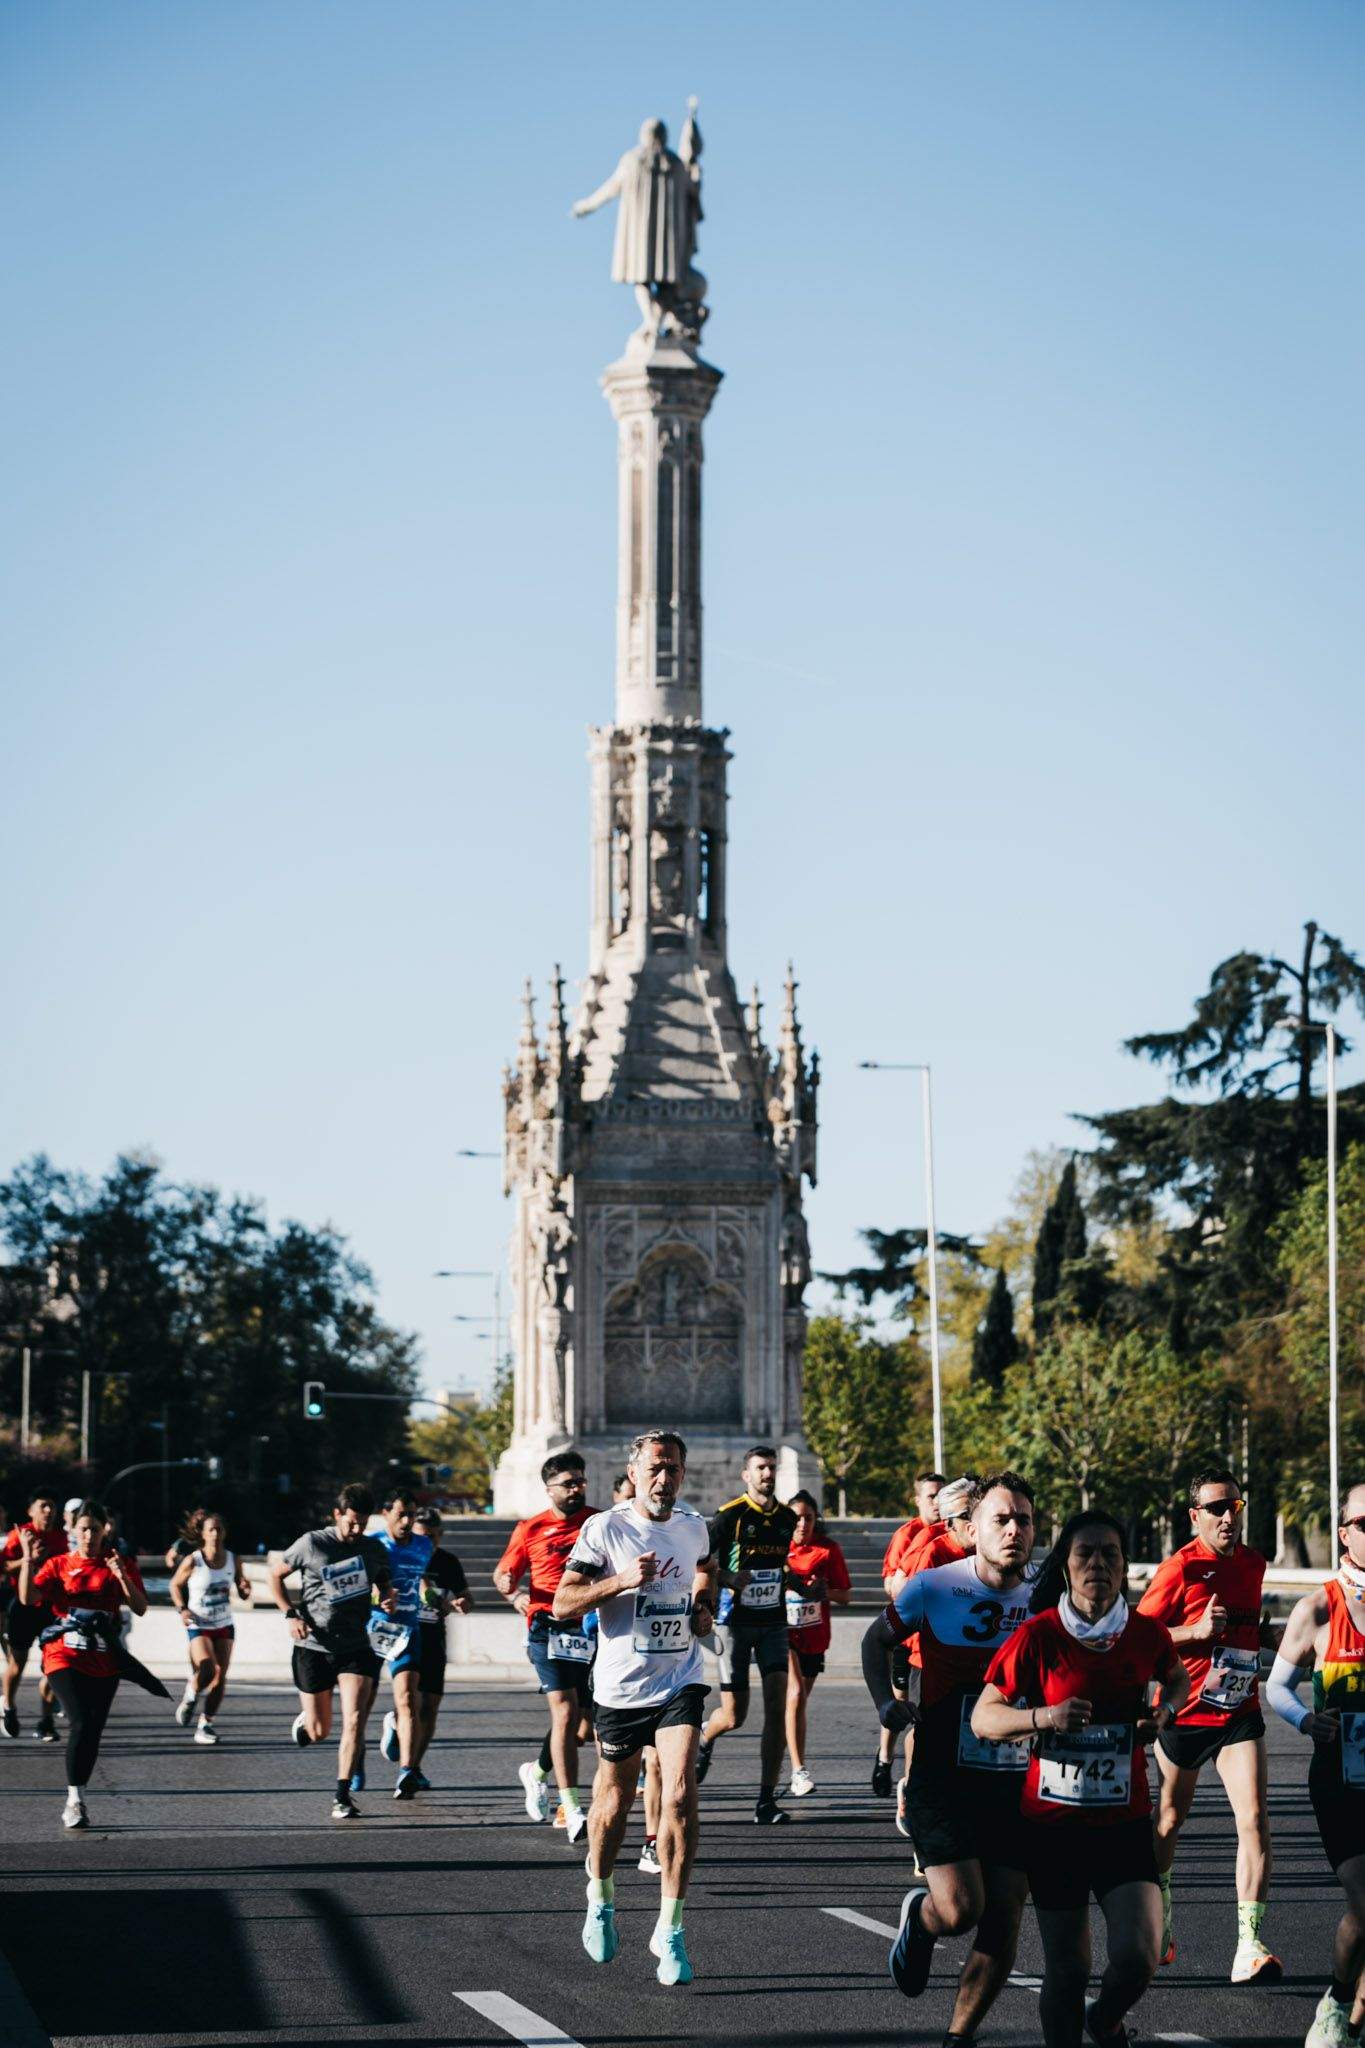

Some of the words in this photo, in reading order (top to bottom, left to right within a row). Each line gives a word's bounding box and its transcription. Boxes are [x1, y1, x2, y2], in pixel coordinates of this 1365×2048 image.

[749, 1585, 777, 1598] 1047
[650, 1619, 683, 1638] 972
[961, 1600, 1005, 1642] 3
[558, 1638, 589, 1651] 1304
[1056, 1758, 1116, 1780] 1742
